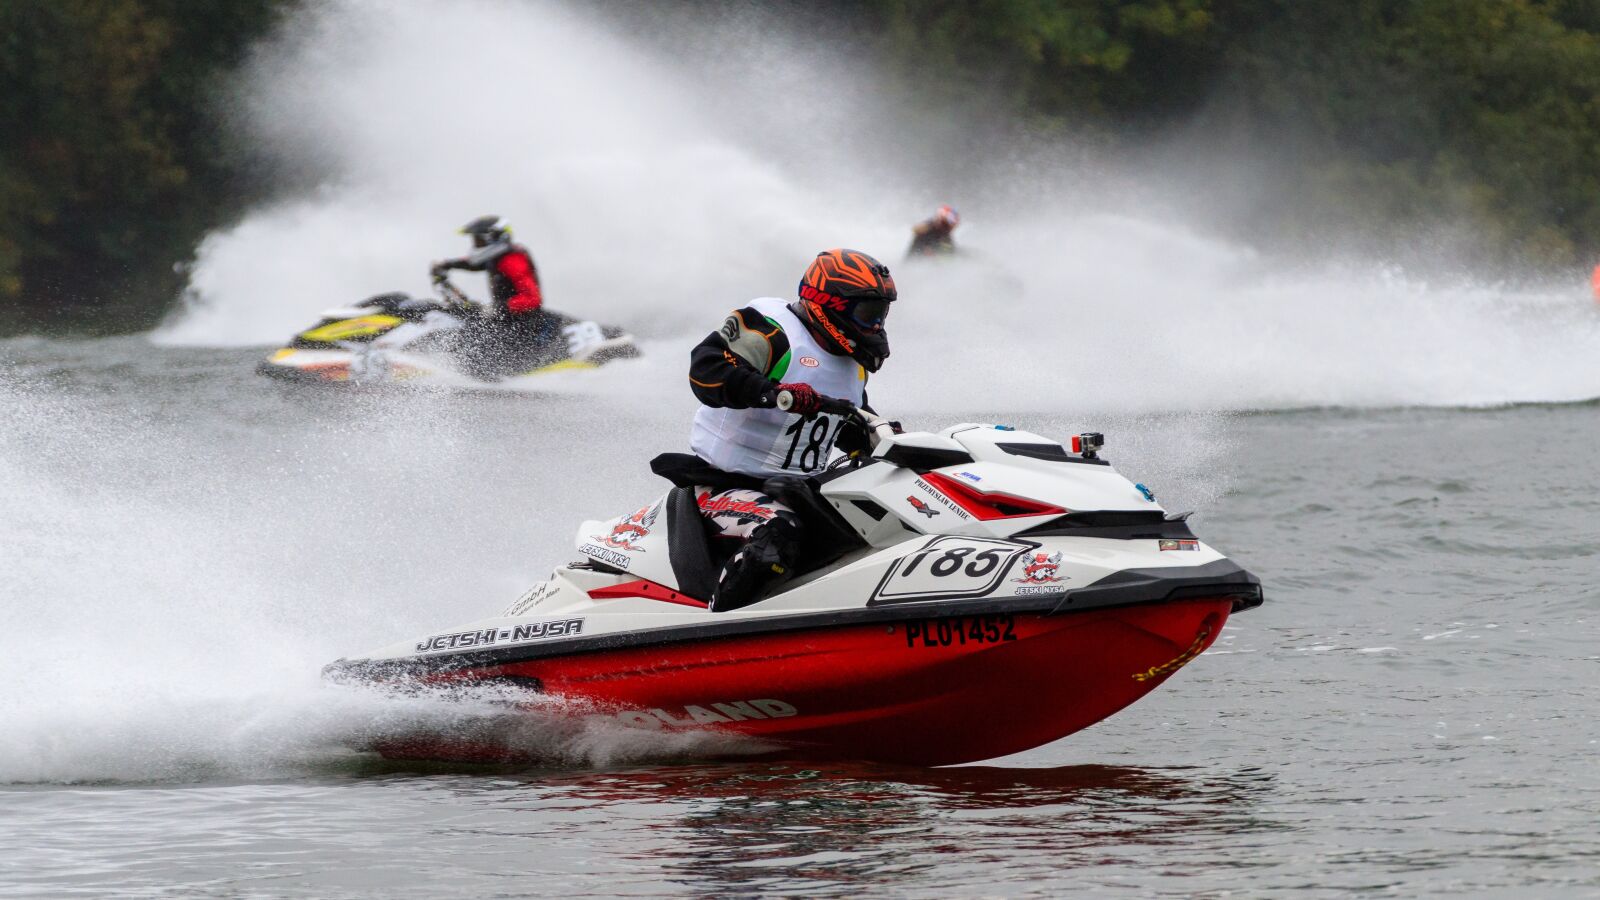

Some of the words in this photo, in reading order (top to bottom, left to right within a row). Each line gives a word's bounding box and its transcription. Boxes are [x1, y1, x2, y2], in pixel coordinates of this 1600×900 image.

[800, 285, 849, 312] 100%
[577, 543, 607, 560] JETSKI
[605, 550, 631, 569] NYSA
[901, 548, 1001, 578] 185
[1015, 586, 1043, 596] JETSKI
[1044, 585, 1065, 594] NYSA
[905, 616, 1018, 648] PL01452
[615, 699, 798, 730] OLAND
